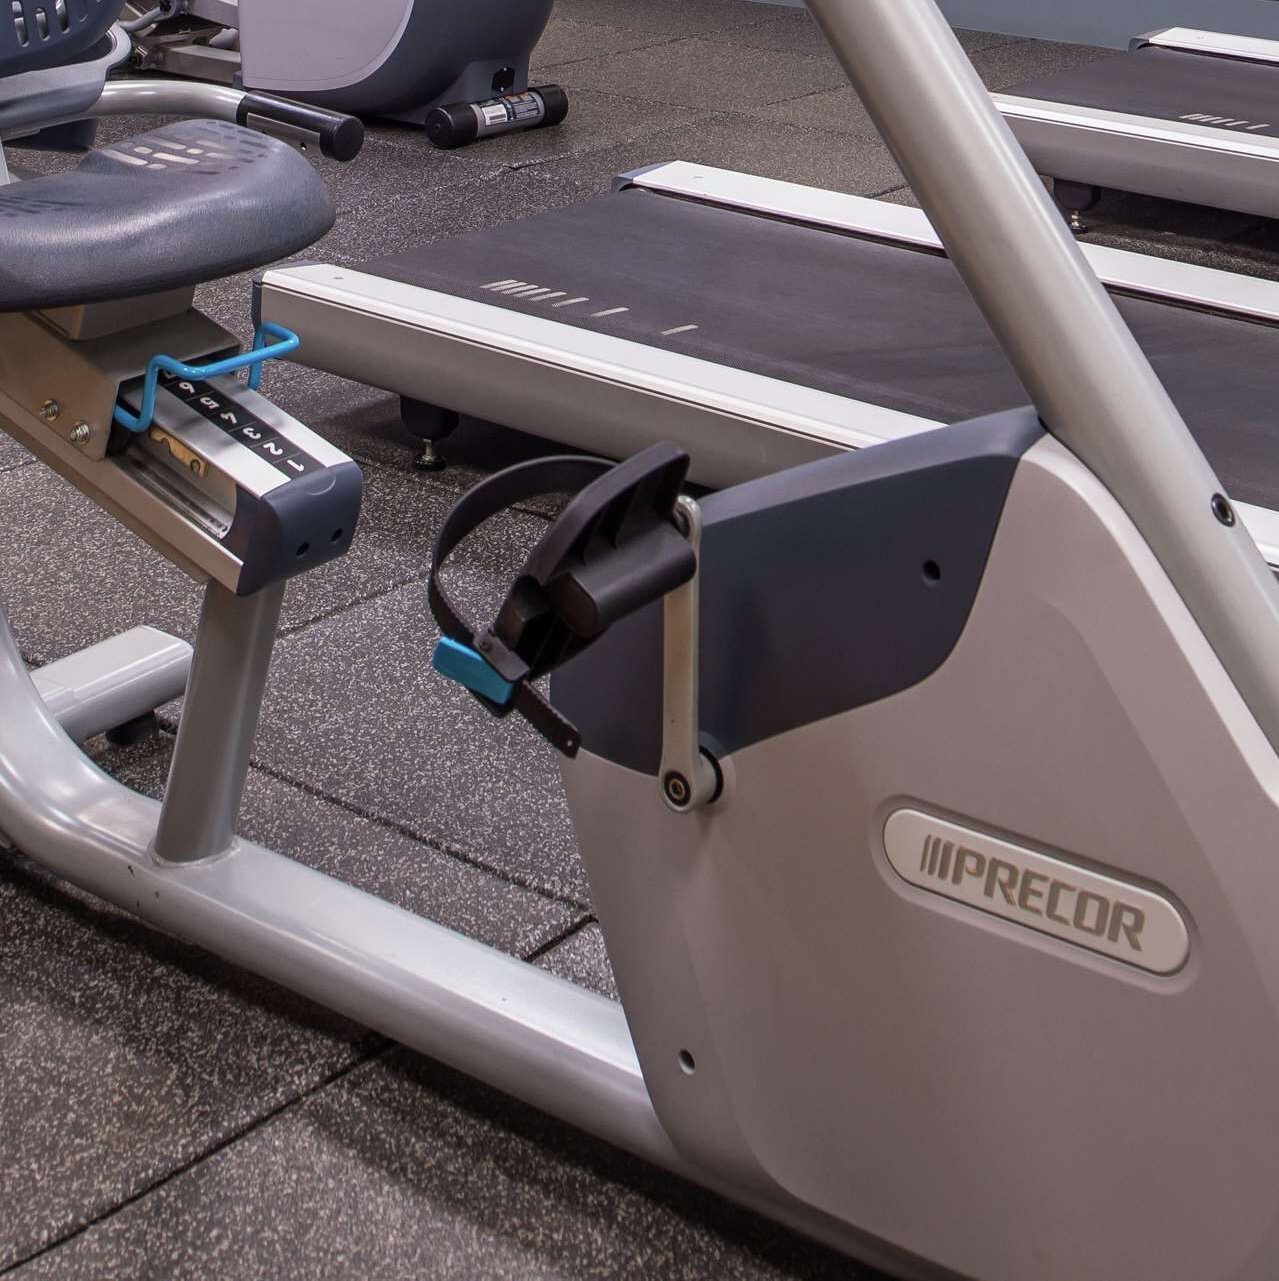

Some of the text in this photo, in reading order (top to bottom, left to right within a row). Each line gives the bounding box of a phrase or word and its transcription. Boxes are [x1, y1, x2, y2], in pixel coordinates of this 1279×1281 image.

[178, 382, 195, 394] 6
[200, 396, 220, 409] 5
[242, 427, 262, 440] 3
[263, 442, 284, 456] 2
[287, 459, 305, 472] 1
[952, 845, 1148, 952] PRECOR
